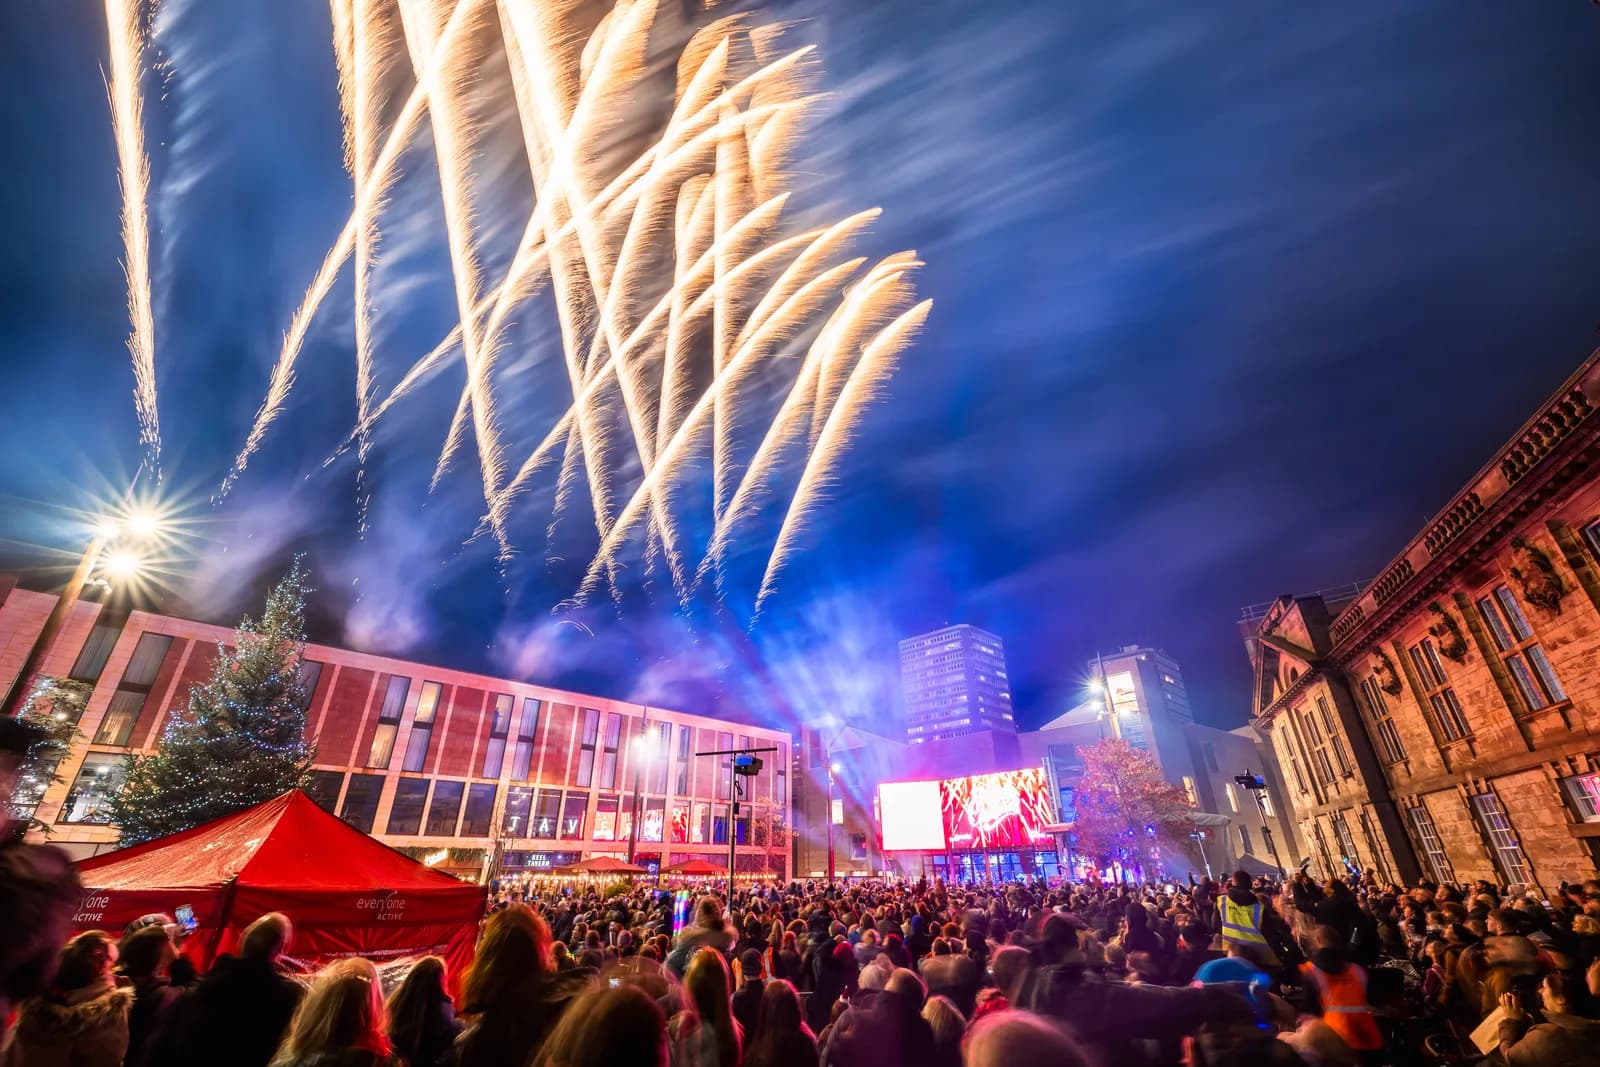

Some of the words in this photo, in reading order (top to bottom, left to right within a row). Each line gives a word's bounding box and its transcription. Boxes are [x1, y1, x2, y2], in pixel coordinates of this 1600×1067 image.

[356, 890, 406, 912] everyone
[71, 912, 104, 922] ACTIVE
[376, 912, 404, 921] ACTIVE
